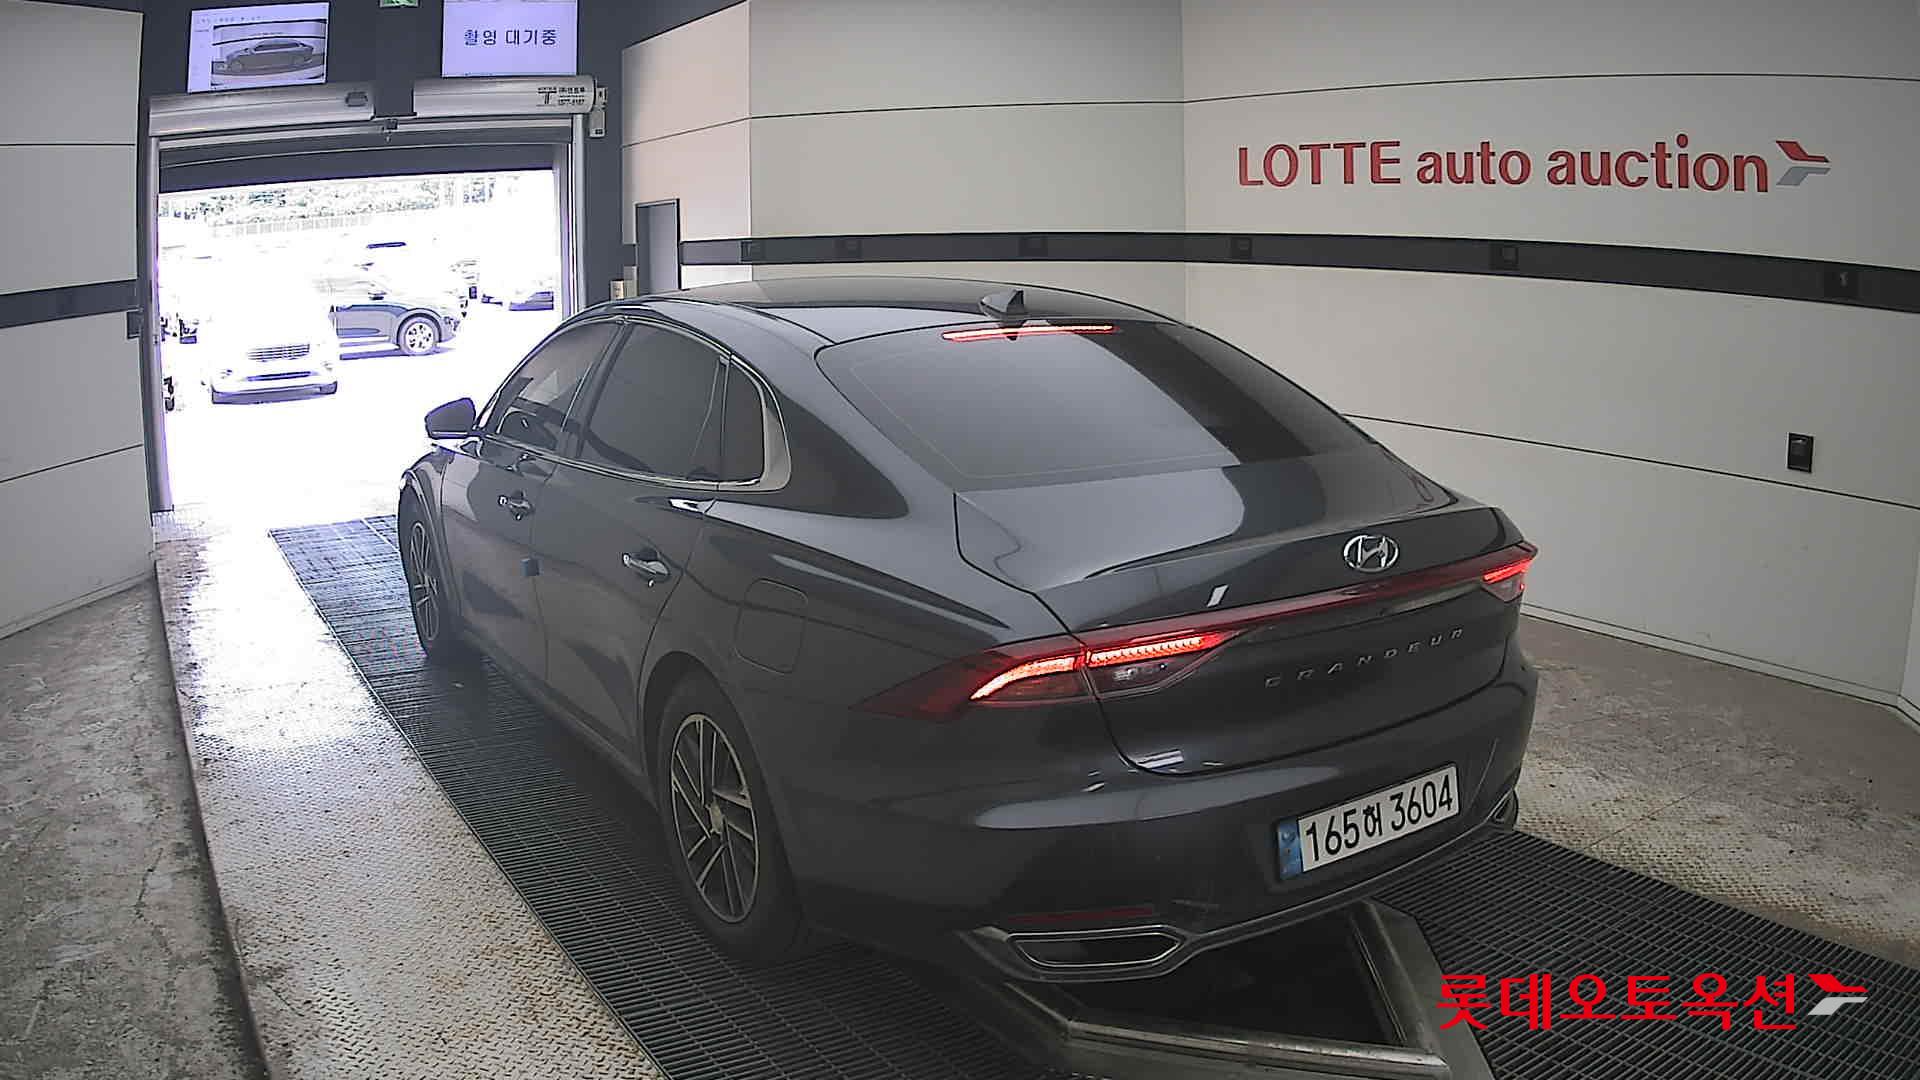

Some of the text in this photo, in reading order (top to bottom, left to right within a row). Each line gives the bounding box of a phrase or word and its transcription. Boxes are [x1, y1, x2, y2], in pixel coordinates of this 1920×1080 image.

[505, 29, 557, 46] 대기중
[1237, 134, 1769, 193] LOTTE auto auction
[1264, 628, 1465, 689] GRANDEUR
[1304, 774, 1454, 862] 165허 3604
